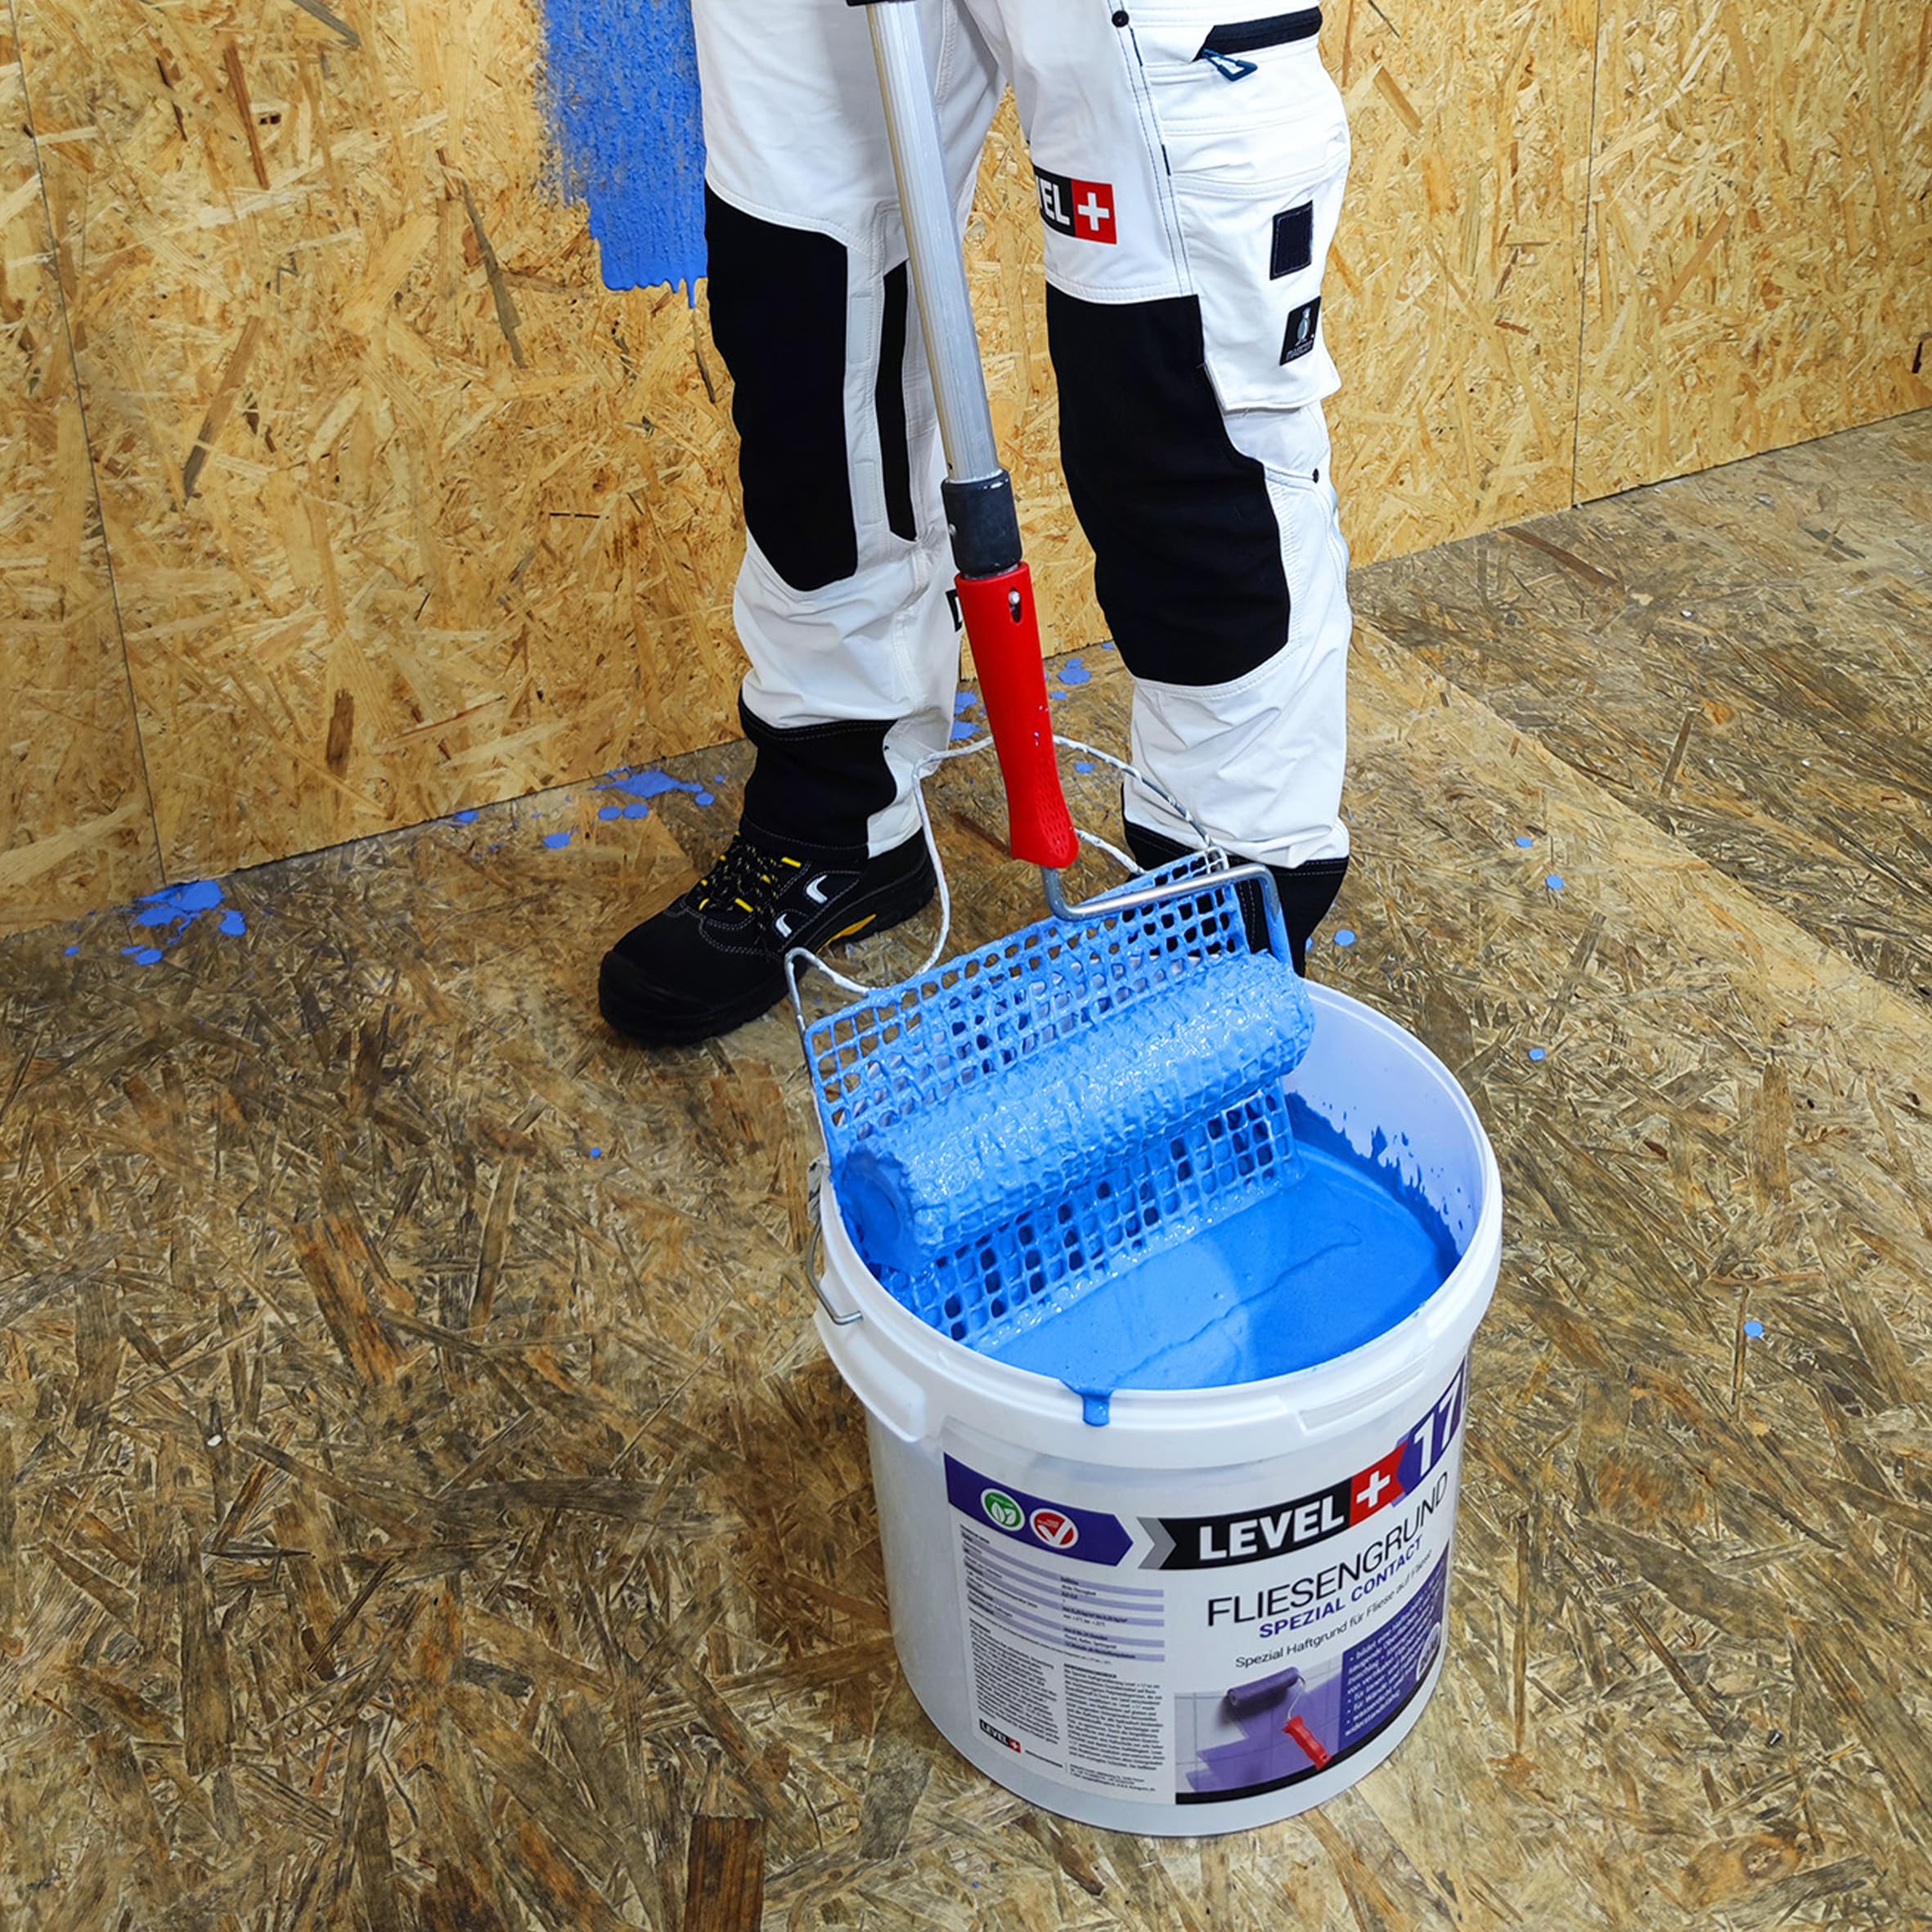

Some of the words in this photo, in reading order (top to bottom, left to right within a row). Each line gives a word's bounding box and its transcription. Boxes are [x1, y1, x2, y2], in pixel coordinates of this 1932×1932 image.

[1413, 1369, 1461, 1477] 17
[1198, 1494, 1345, 1561] LEVEL
[1207, 1471, 1448, 1626] FLIESENGRUND
[1259, 1597, 1346, 1638] SPEZIAL
[1351, 1536, 1421, 1602] CONTACT
[1235, 1646, 1284, 1669] Spezial
[1287, 1620, 1347, 1655] Haftgrund
[1350, 1611, 1364, 1628] für
[981, 1722, 1009, 1745] LEVEL
